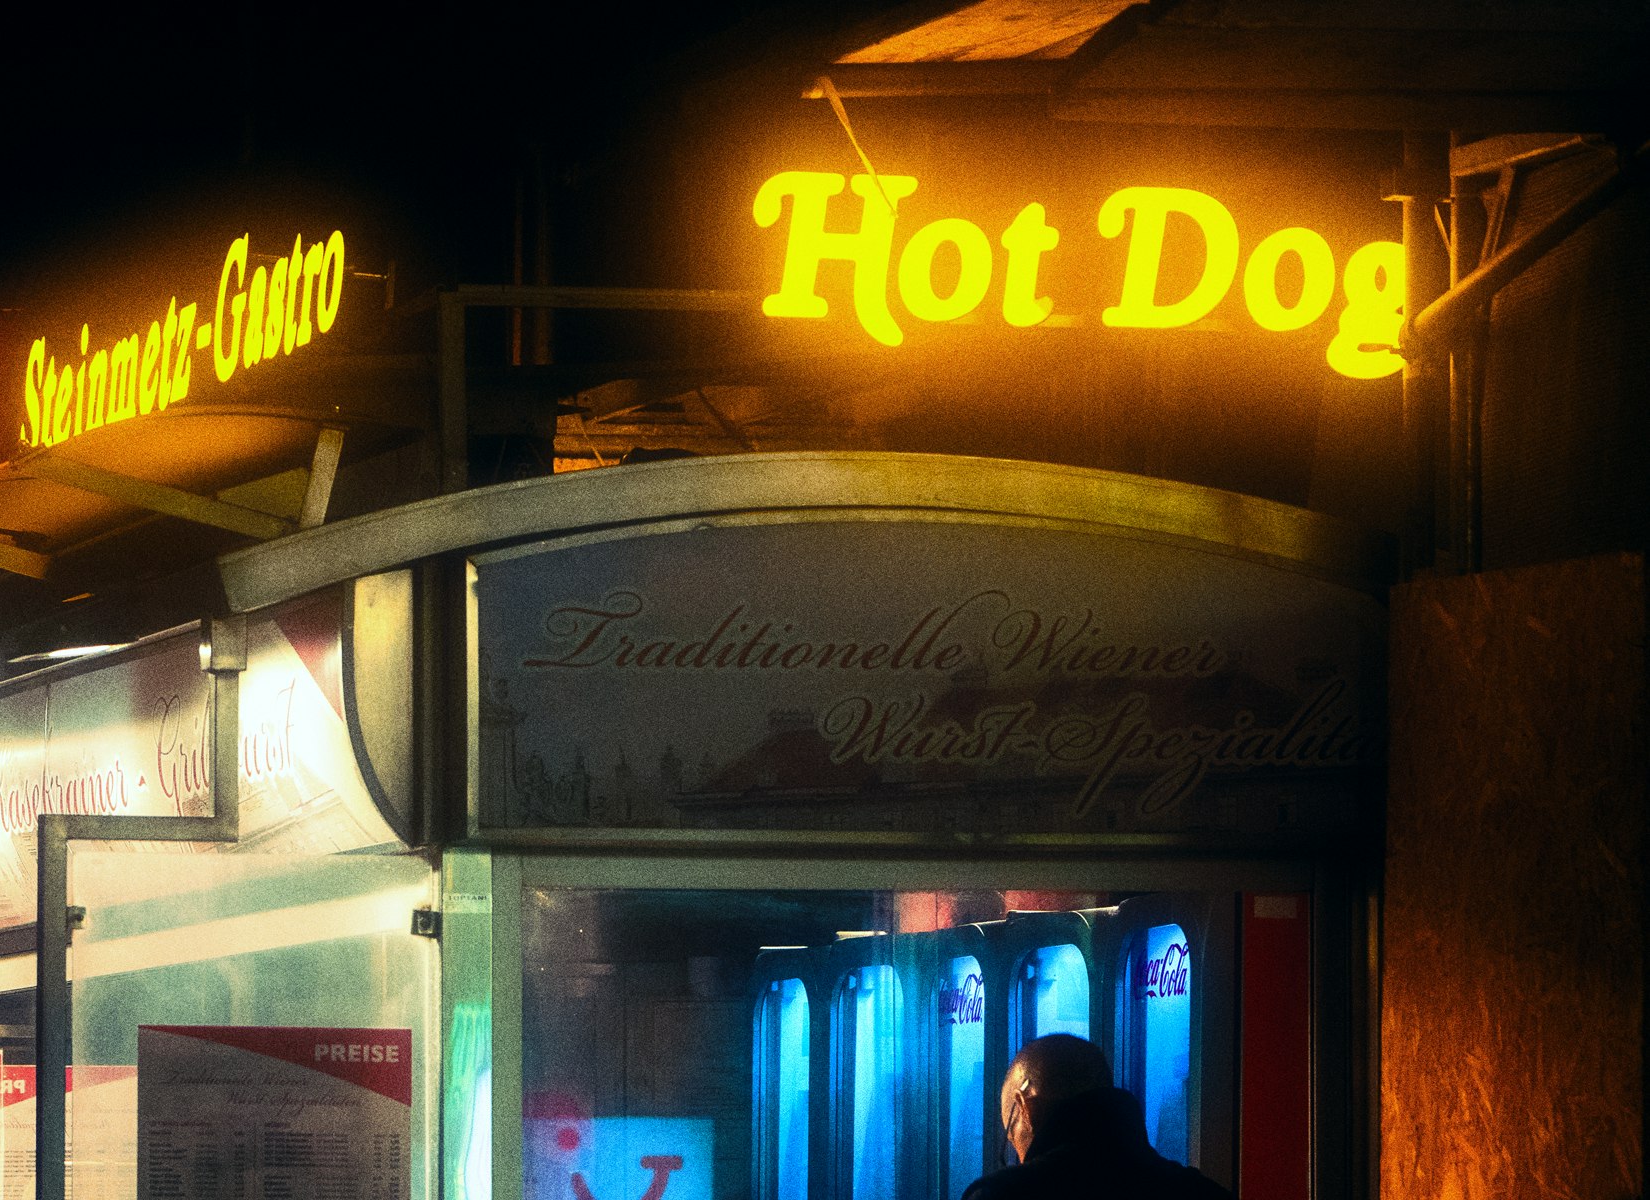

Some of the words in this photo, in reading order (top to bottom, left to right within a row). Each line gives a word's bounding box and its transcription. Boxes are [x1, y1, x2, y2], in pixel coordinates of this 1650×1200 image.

[20, 230, 345, 448] Steinmetz-Gastro
[753, 171, 1060, 347] Hot
[1068, 186, 1406, 380] Dog
[523, 590, 1010, 672] Traditionelle
[990, 606, 1226, 680] Wiener
[310, 1042, 401, 1064] PREISE
